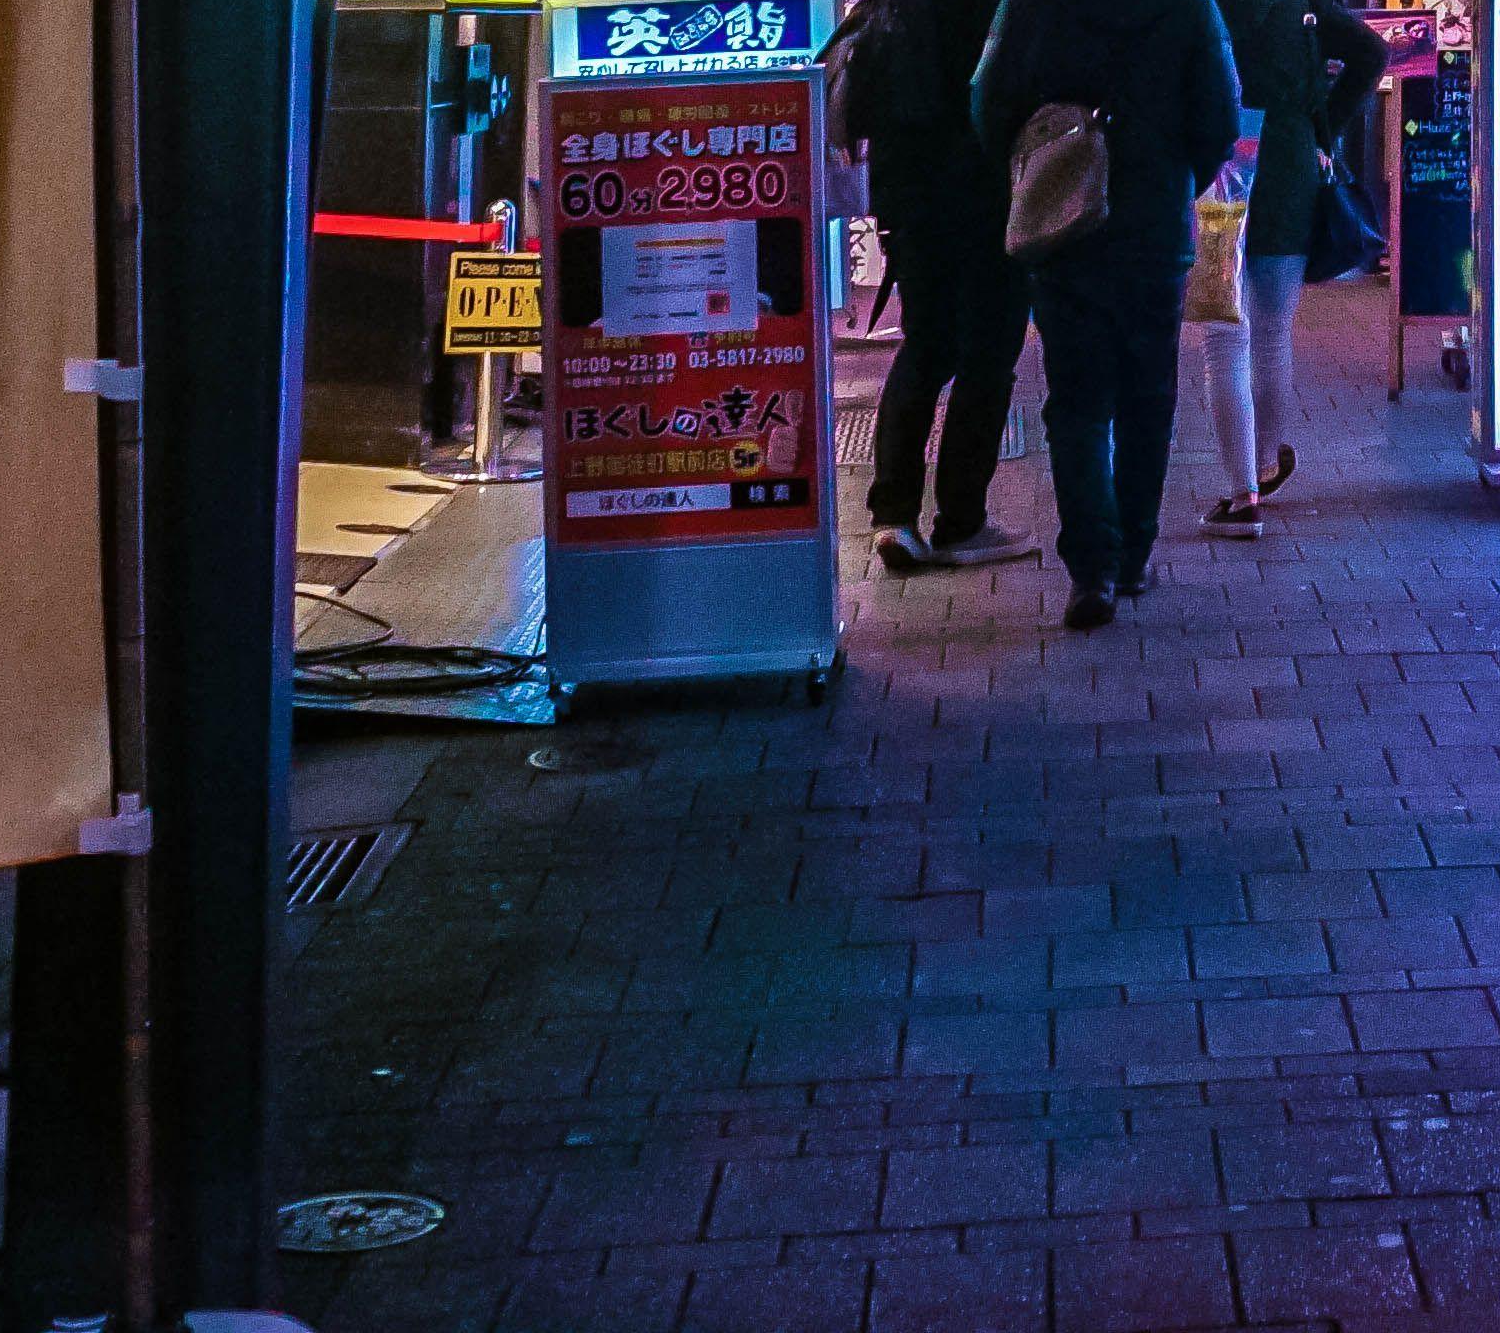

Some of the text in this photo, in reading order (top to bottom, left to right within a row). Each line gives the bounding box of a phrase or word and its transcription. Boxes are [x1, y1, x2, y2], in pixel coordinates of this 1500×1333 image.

[561, 123, 798, 164] 全身ほぐし専門店
[565, 385, 791, 442] ほぐしの達人
